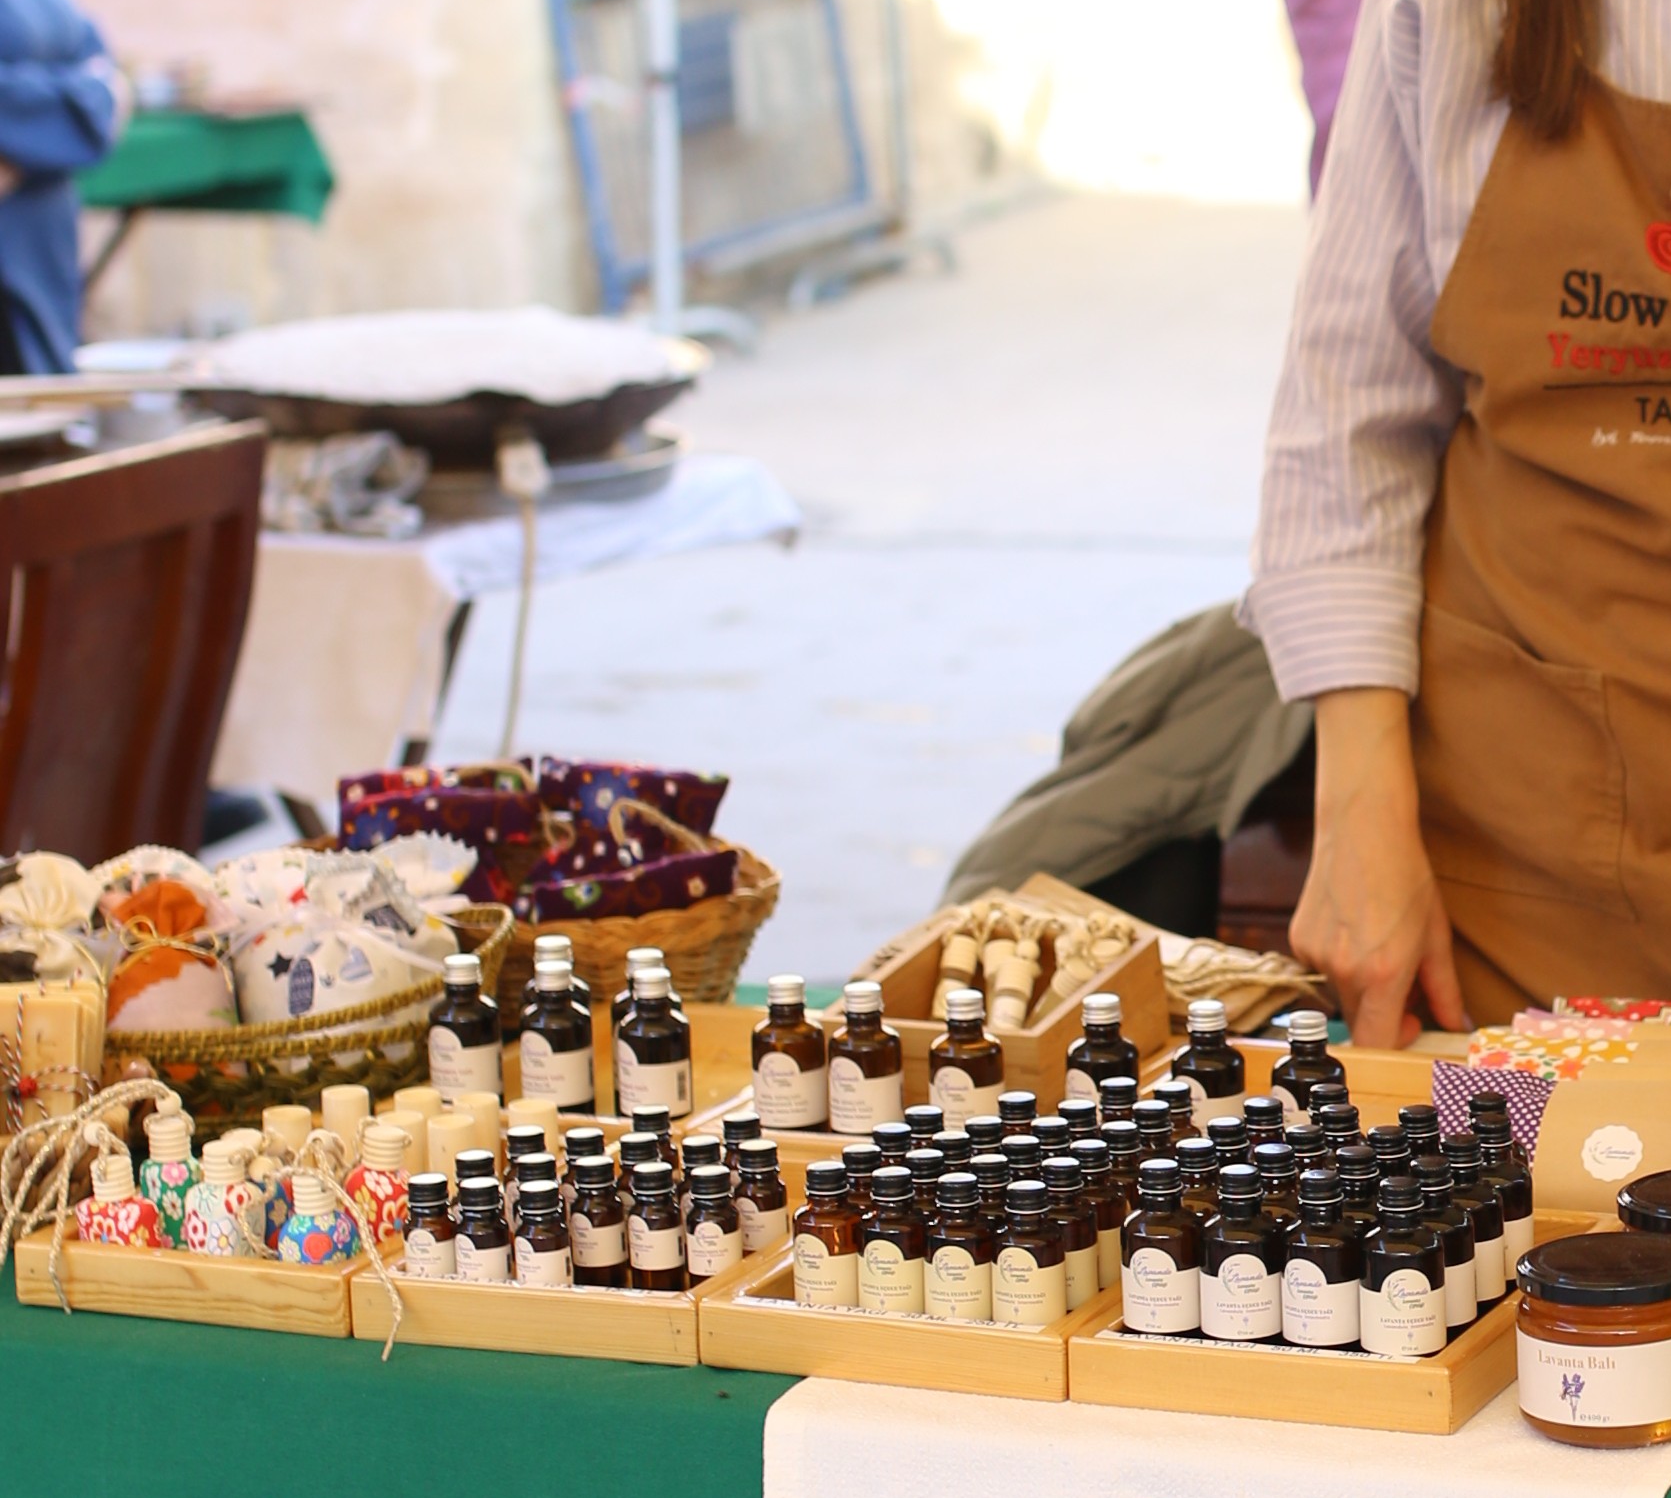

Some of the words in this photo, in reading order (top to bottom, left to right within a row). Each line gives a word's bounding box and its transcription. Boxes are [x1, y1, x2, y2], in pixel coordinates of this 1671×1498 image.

[1559, 269, 1669, 329] Slow
[1537, 1349, 1585, 1369] Lavanta
[1588, 1356, 1616, 1370] Balı
